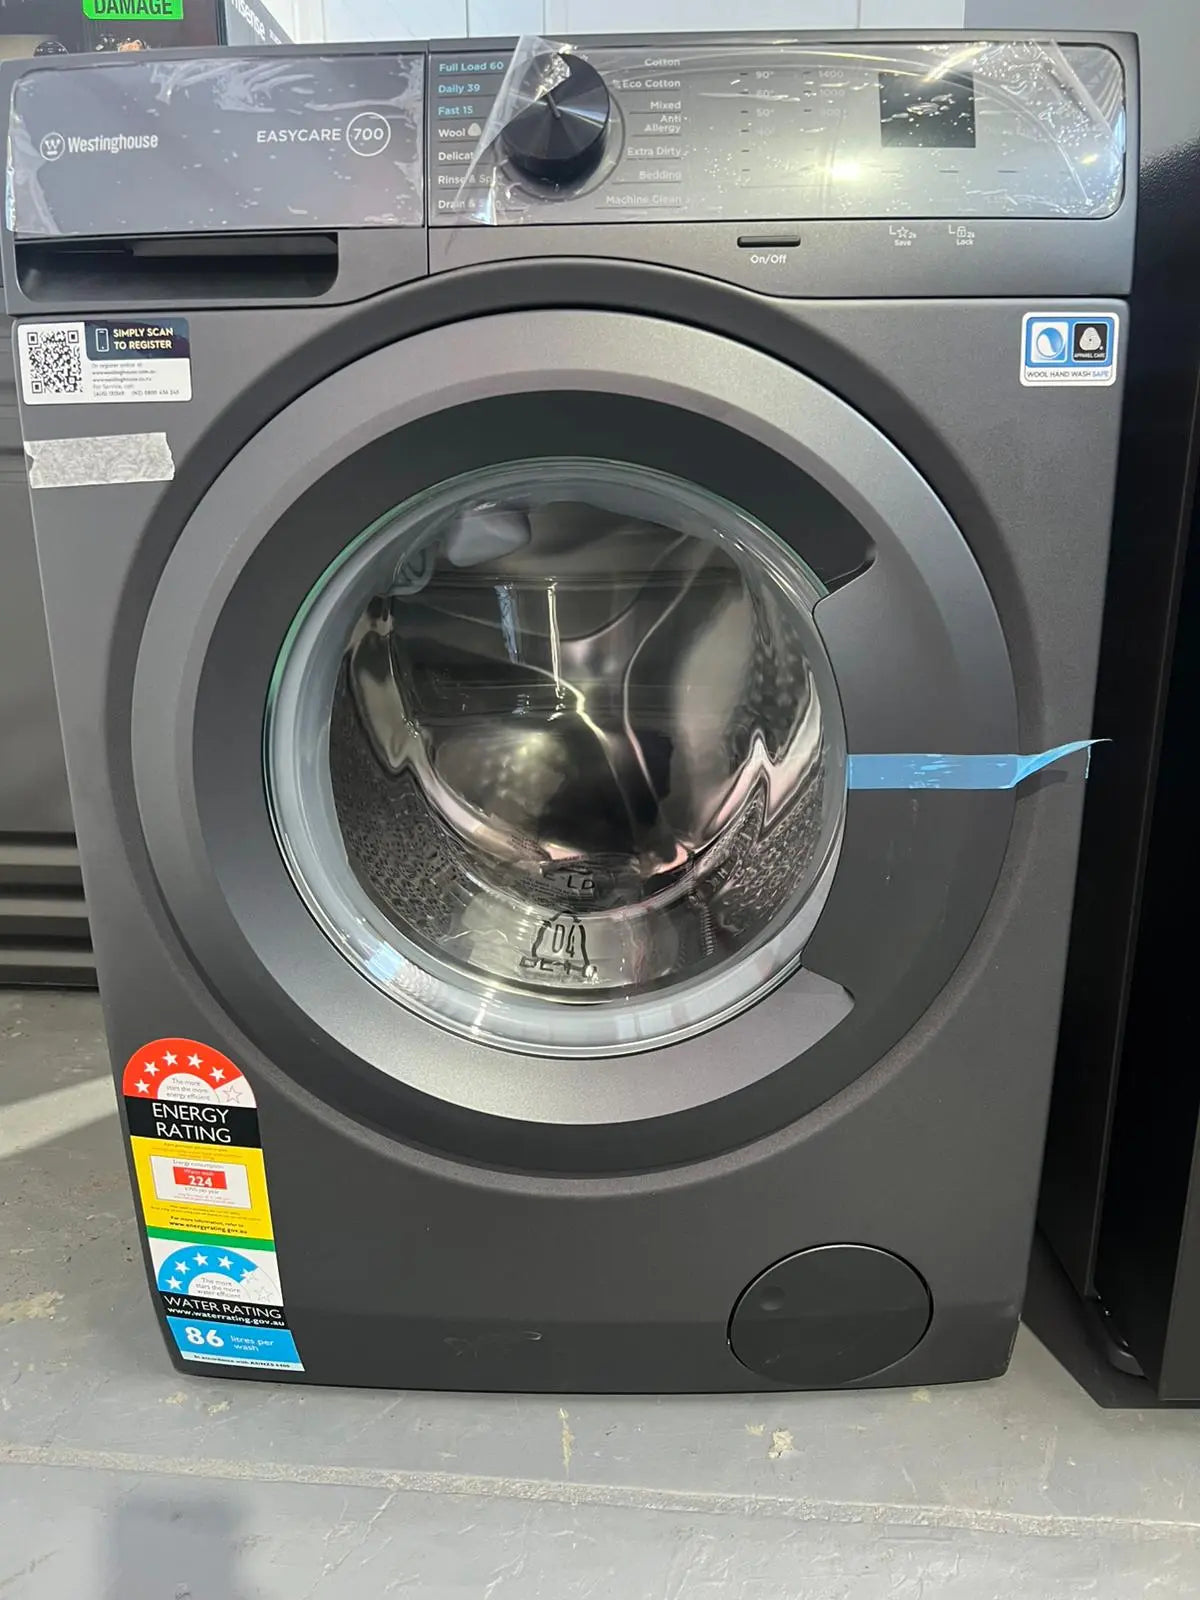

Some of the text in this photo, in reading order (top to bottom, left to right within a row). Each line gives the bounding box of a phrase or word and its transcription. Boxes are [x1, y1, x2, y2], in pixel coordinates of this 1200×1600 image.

[94, 0, 173, 15] DAMAGE
[439, 61, 504, 72] Full Load 60
[644, 58, 681, 67] Cotton
[438, 83, 481, 94] Daily 39
[622, 79, 681, 88] Eco Cotton
[438, 105, 473, 115] Fast 15
[650, 101, 682, 110] Mixed
[660, 114, 682, 123] Anti
[438, 128, 466, 138] Wool
[644, 123, 682, 134] Allergy
[256, 127, 384, 143] EASYCARE 700
[67, 133, 159, 154] Westinghouse
[438, 151, 474, 161] Delicat
[627, 146, 682, 157] Extra Dirty
[606, 194, 648, 204] Machine
[894, 239, 912, 247] Save
[956, 238, 974, 246] Lock
[750, 254, 787, 265] On/Off
[113, 327, 174, 338] SIMPLY SCAN
[113, 340, 173, 350] TO REGISTER
[152, 1102, 229, 1124] ENERGY
[156, 1121, 232, 1144] RATING
[188, 1174, 213, 1187] 224
[163, 1295, 282, 1319] WATER RATING
[167, 1307, 286, 1327] www.waterrating.gov.au
[185, 1326, 225, 1348] 86
[230, 1335, 275, 1347] litres per
[233, 1343, 260, 1352] wash
